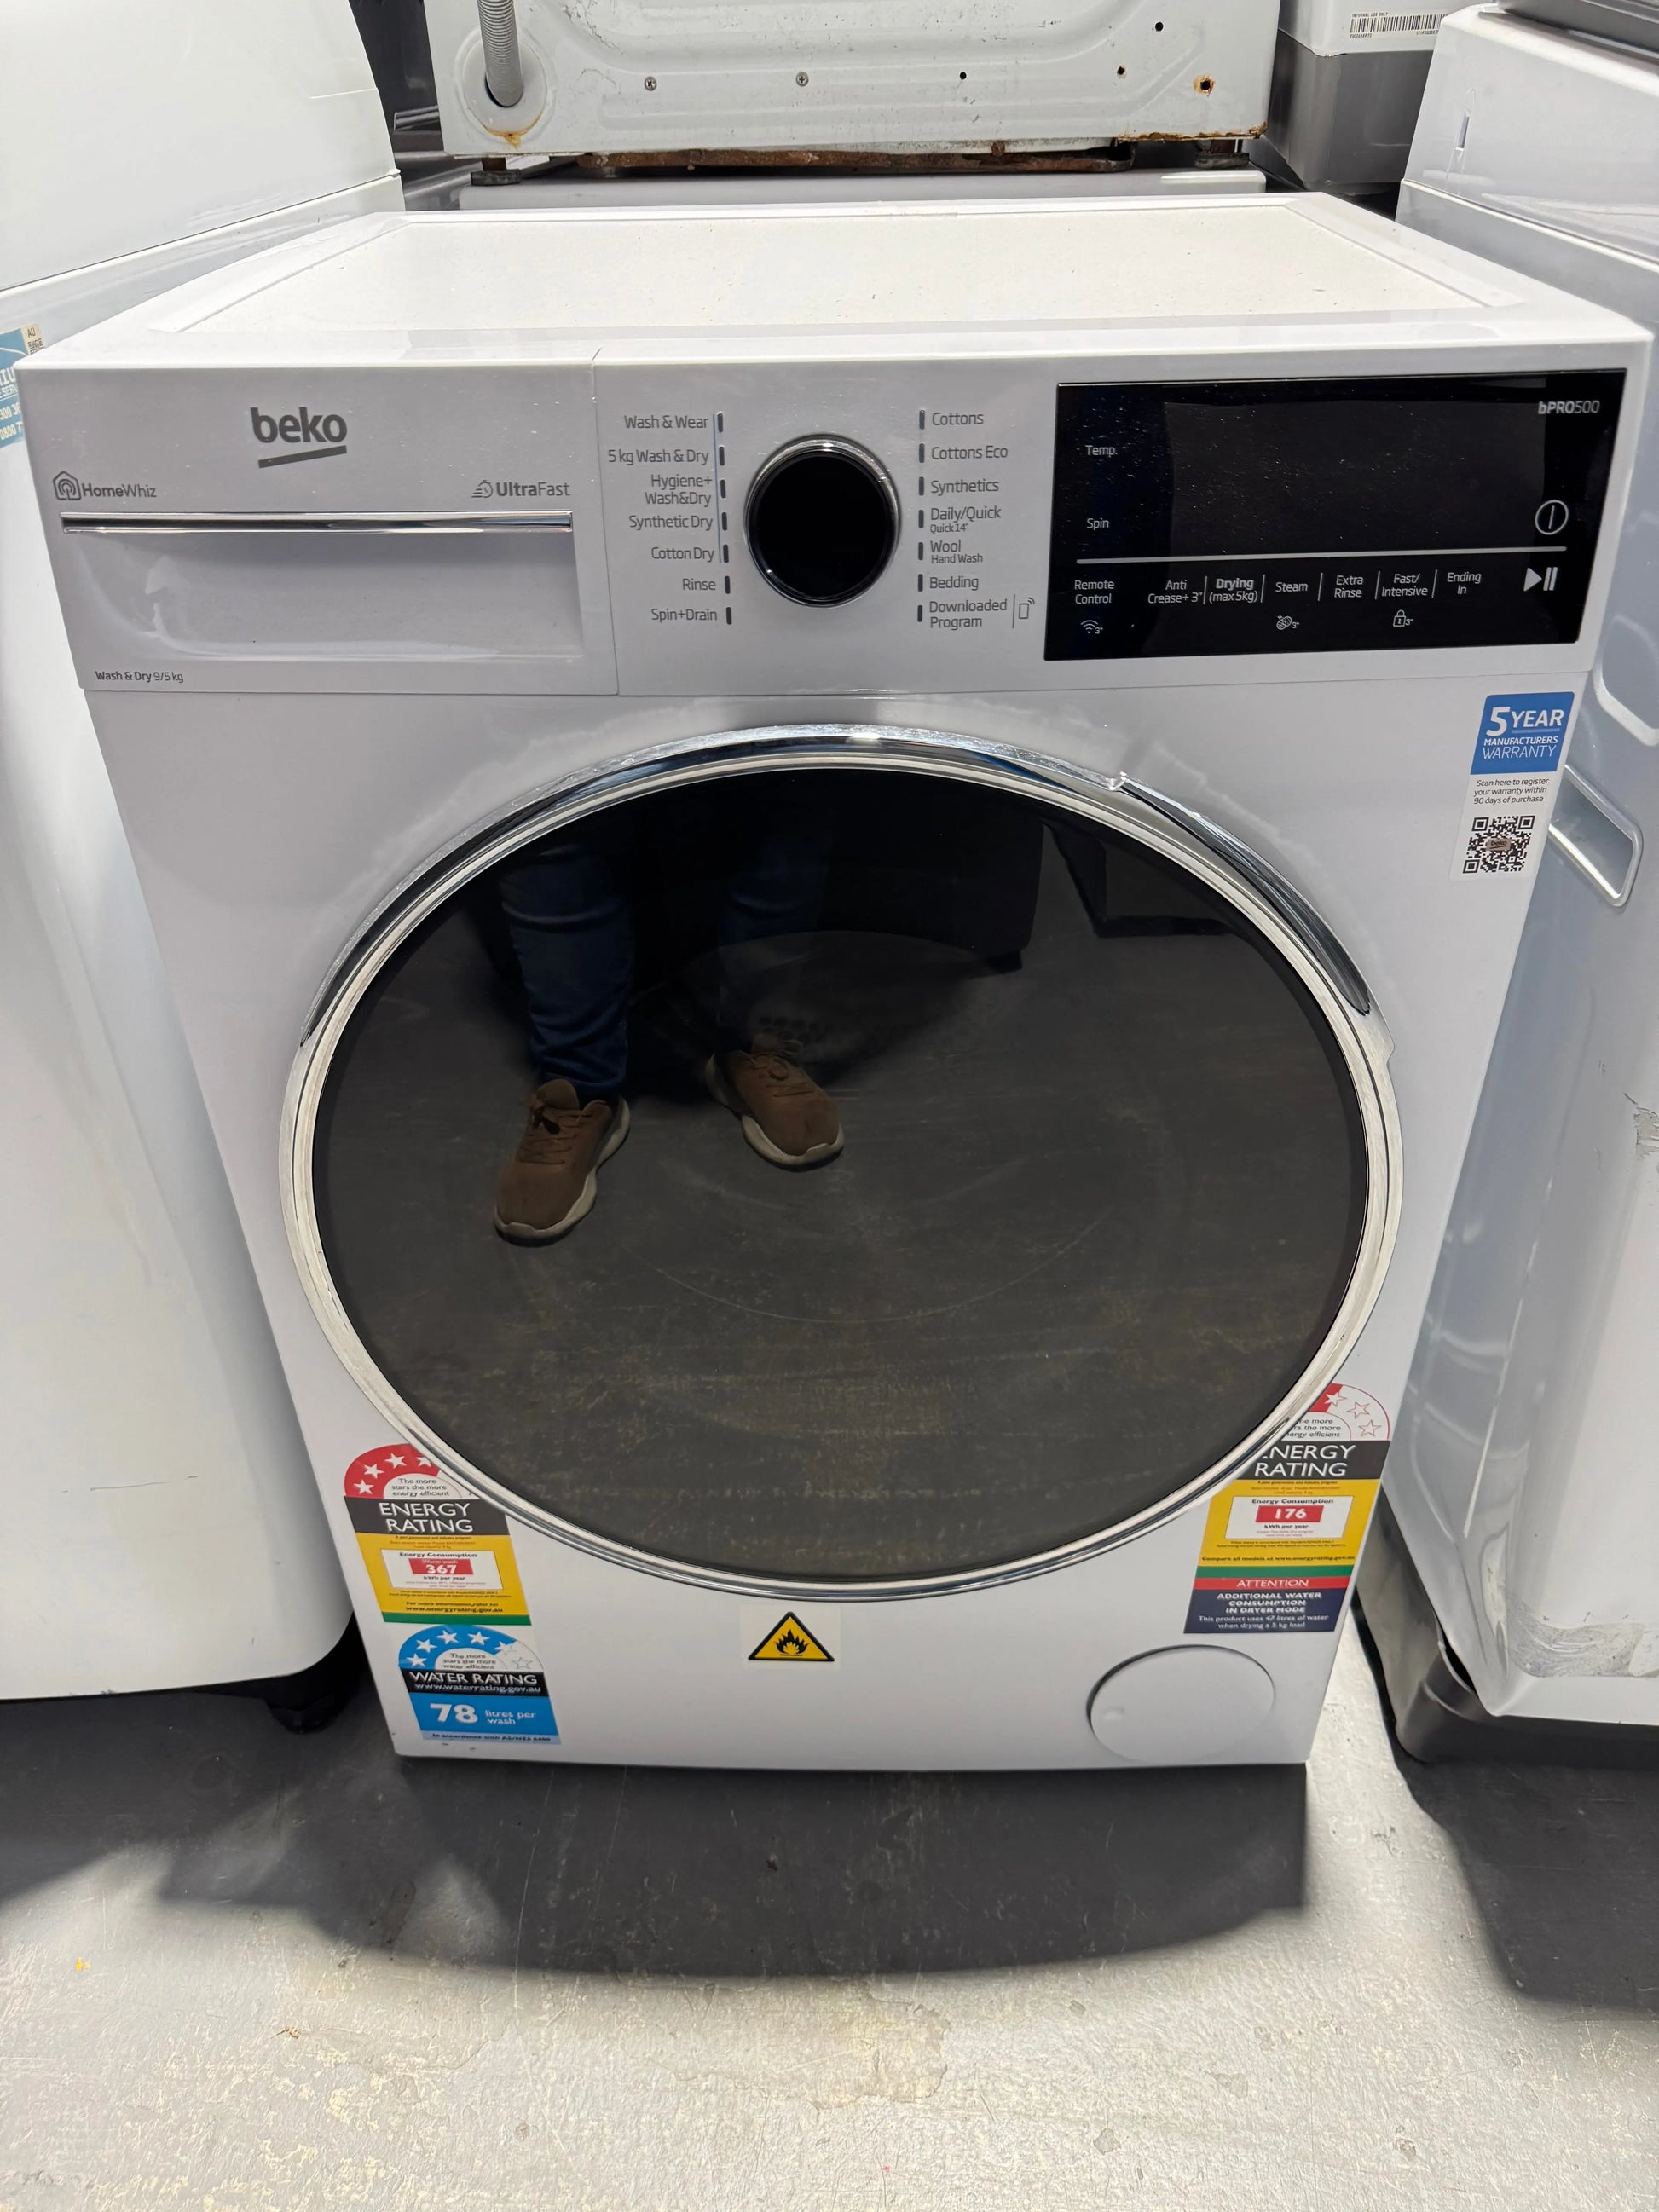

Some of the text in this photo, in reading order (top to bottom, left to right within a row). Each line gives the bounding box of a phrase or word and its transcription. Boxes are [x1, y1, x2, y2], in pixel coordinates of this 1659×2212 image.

[1538, 401, 1601, 415] bPRO500
[251, 407, 347, 443] beko
[625, 415, 709, 429] Wash & Wear
[932, 412, 984, 426] Cottons
[608, 449, 709, 465] 5 kg Wash & Dry
[931, 445, 1009, 460] Cottons Eco
[1085, 445, 1119, 458] Temp.
[651, 475, 713, 490] Hygiene+
[930, 478, 1000, 496] Synthetics
[82, 483, 156, 498] HomeWhiz
[497, 482, 570, 497] UltraFast
[645, 492, 711, 507] Wash&Dry
[930, 505, 1002, 522] Daily/Quick
[629, 515, 713, 531] Synthetic Dry
[930, 523, 954, 534] Quick
[1087, 518, 1109, 530] Spin
[930, 540, 962, 553] Wool
[651, 546, 714, 563] Cotton Dry
[931, 554, 983, 564] Hand Wash
[929, 577, 980, 591] Bedding
[1336, 575, 1363, 586] Extra
[1393, 573, 1420, 584] Fast/
[1447, 571, 1482, 584] Ending
[683, 578, 716, 591] Rinse
[1074, 579, 1115, 591] Remote
[1165, 580, 1187, 591] Anti
[1216, 578, 1254, 591] Drying
[1275, 581, 1308, 592] Steam
[1457, 585, 1467, 595] In
[1209, 592, 1258, 604] (max 5kg)
[1334, 588, 1362, 598] Rinse
[1381, 586, 1428, 597] Intensive
[1075, 593, 1113, 604] Control
[1147, 593, 1189, 604] Crease+
[929, 598, 1008, 614] Downloaded
[651, 608, 717, 623] Spin+Drain
[930, 616, 982, 631] Program
[95, 672, 184, 683] Wash & Dry 9/5 kg
[1486, 707, 1564, 736] 5 YEAR
[1483, 736, 1558, 746] MANUFACTURERS
[1483, 745, 1557, 759] WARRANTY
[1521, 777, 1549, 787] register
[1511, 795, 1544, 804] purchase
[1263, 1445, 1356, 1459] NERGY
[1255, 1462, 1348, 1476] RATING
[379, 1502, 470, 1516] ENERGY
[1275, 1508, 1307, 1519] 176
[386, 1518, 474, 1533] RATING
[426, 1564, 457, 1574] 367
[1236, 1579, 1309, 1588] ATTENTION
[409, 1671, 538, 1685] WATER RATING
[414, 1684, 541, 1694] www.waterrating.gov.au
[430, 1703, 478, 1724] 78
